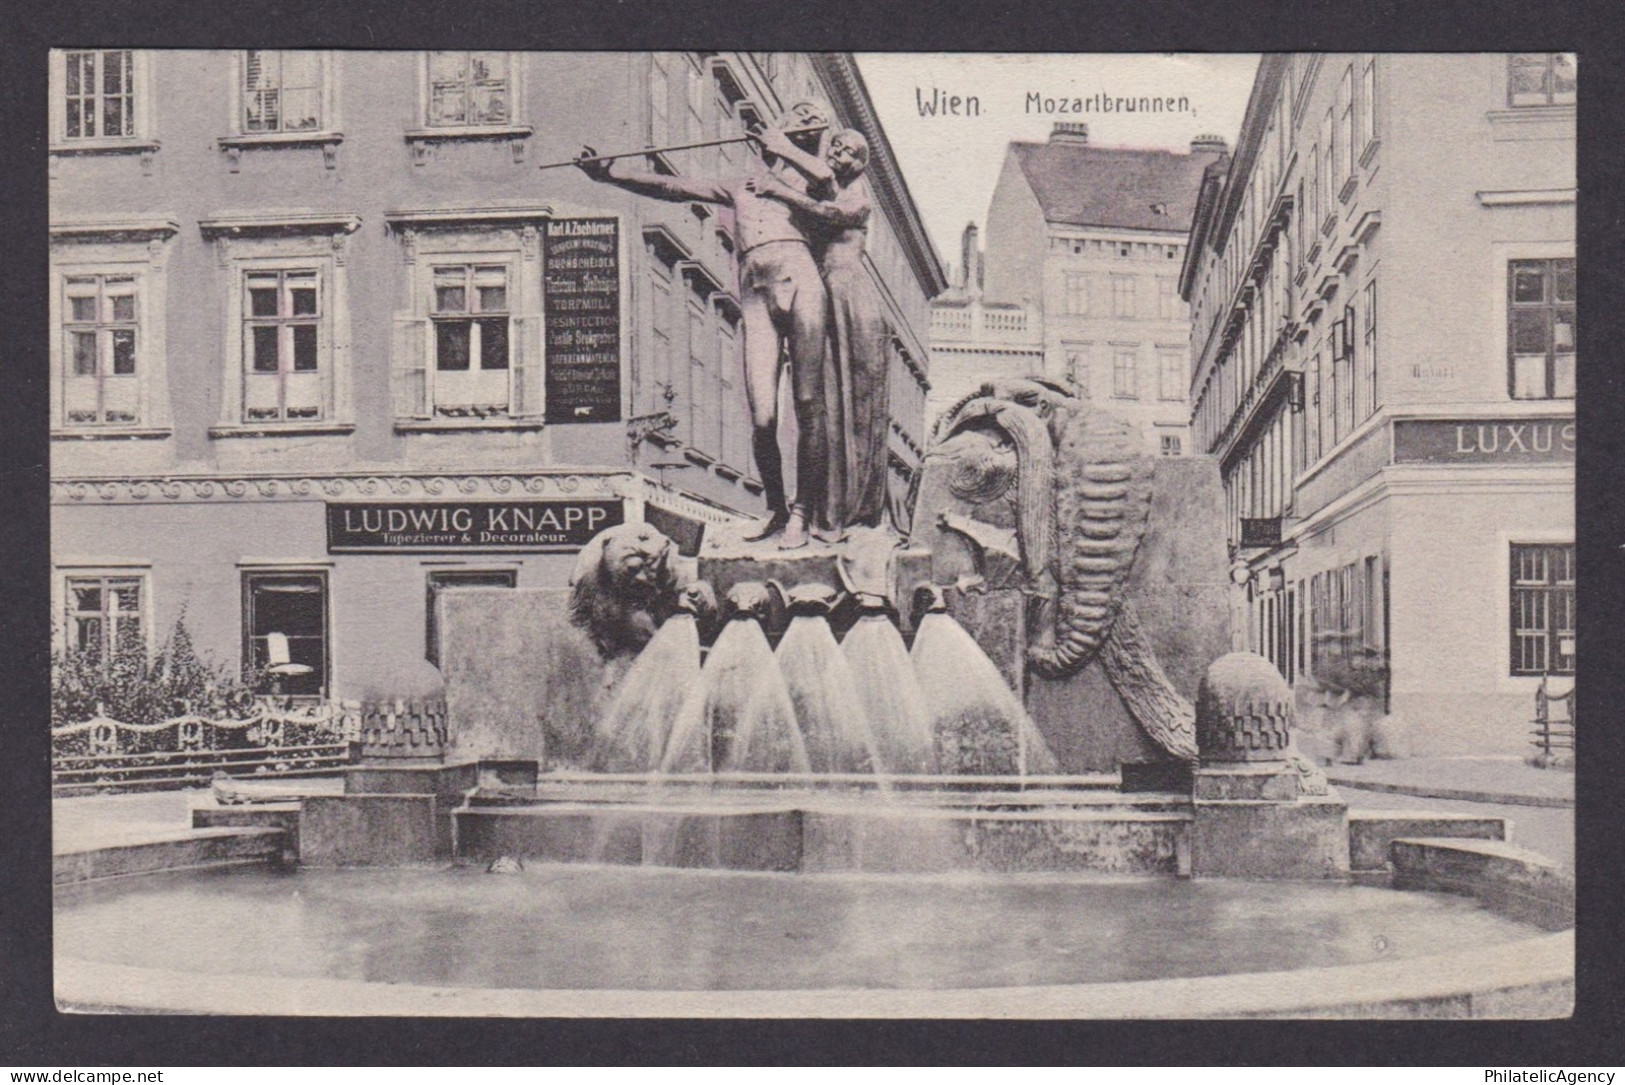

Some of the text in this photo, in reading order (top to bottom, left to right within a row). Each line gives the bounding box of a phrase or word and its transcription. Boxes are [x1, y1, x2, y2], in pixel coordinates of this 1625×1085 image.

[546, 316, 619, 328] DESINFECTION
[344, 507, 607, 533] LUDWIG KNAPP
[382, 532, 456, 545] Tapezierer
[461, 532, 472, 543] &
